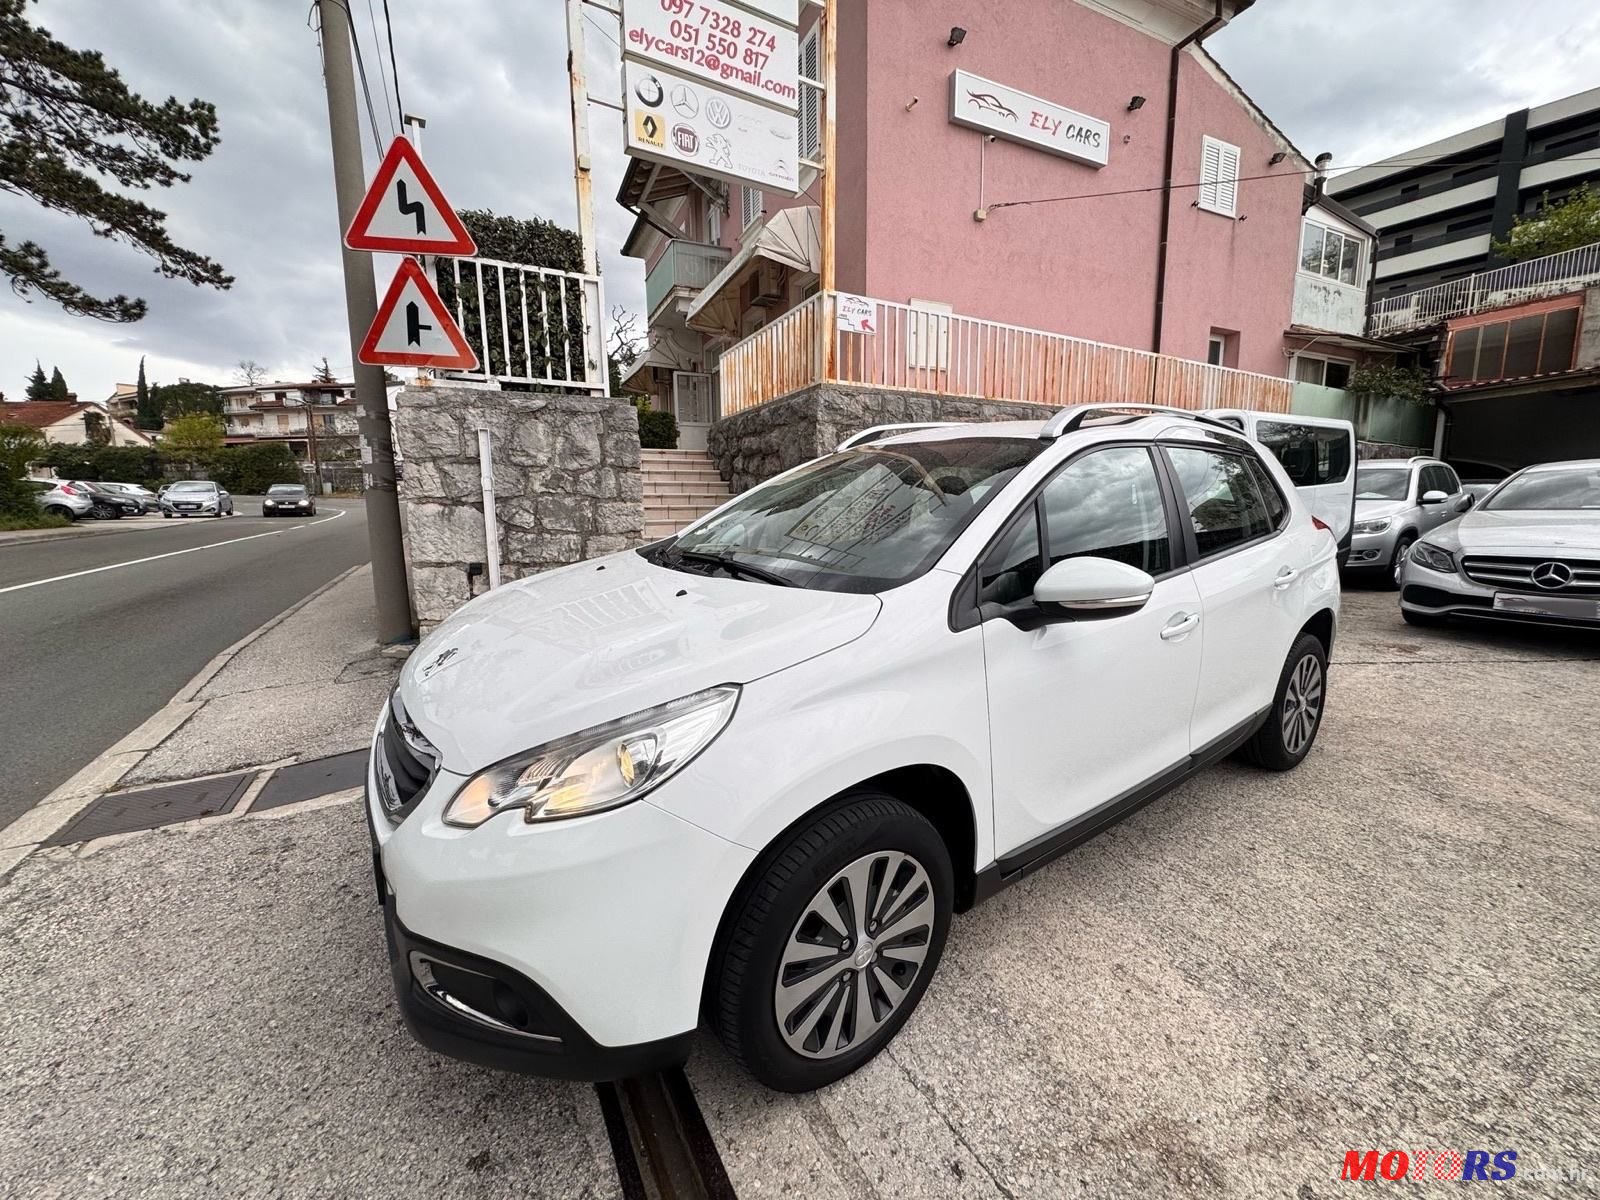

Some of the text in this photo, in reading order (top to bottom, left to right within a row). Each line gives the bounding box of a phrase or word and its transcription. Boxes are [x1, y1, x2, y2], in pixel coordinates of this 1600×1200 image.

[661, 0, 776, 52] 097 7328 274
[670, 20, 769, 70] 051 550 817
[629, 28, 796, 99] elycars12@gmail.com
[677, 132, 694, 150] FIAT
[1029, 111, 1101, 148] ELY CARS
